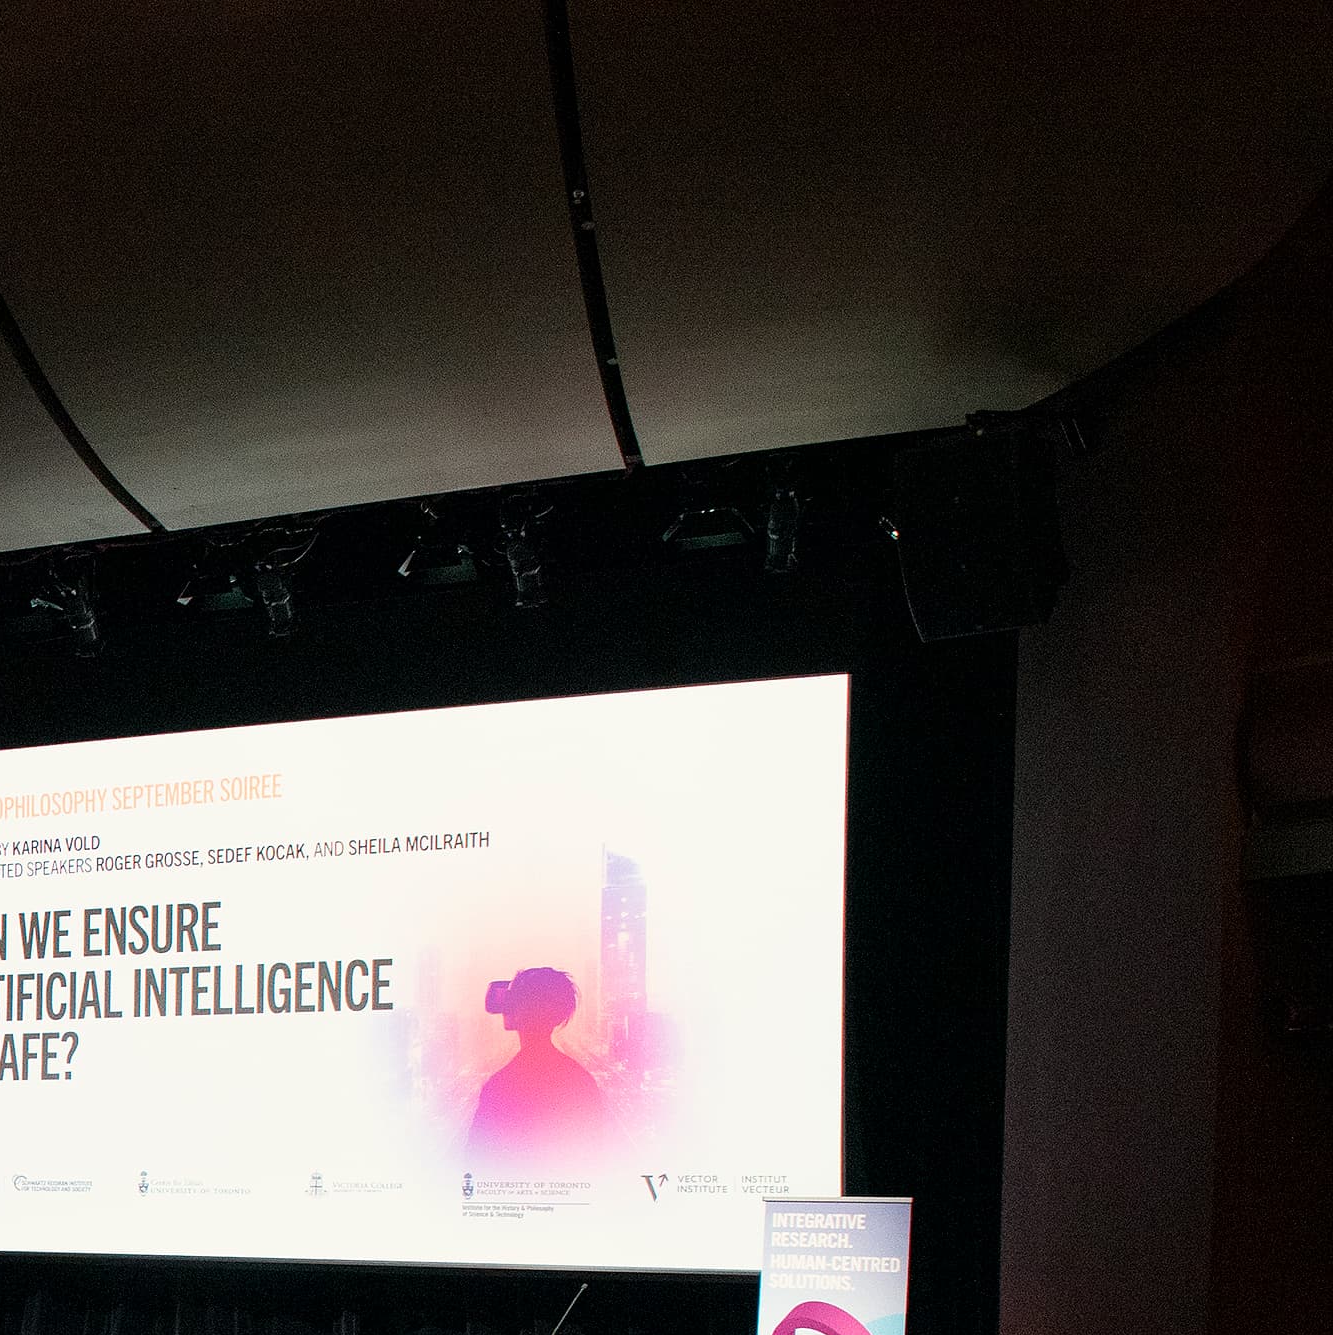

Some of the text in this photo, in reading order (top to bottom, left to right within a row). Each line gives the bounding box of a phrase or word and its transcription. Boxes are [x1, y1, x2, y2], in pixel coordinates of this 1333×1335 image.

[112, 779, 214, 810] SEPTEMBER
[220, 774, 282, 802] SOIREE
[12, 838, 61, 856] KARINA
[65, 835, 100, 852] VOLD
[27, 858, 92, 877] SPEAKERS
[96, 855, 141, 872] ROGER
[145, 850, 204, 868] GROSSE,
[208, 847, 252, 865] SEDEF
[256, 843, 309, 862] KOCAK,
[314, 840, 344, 857] AND
[348, 836, 401, 856] SHEILA
[406, 832, 489, 852] MCILRAITH
[19, 910, 72, 959] WE
[83, 901, 221, 957] ENSURE
[133, 958, 394, 1018] INTELLIGENCE
[773, 1213, 866, 1229] INTEGRATIVE
[771, 1232, 853, 1248] RESEARCH.
[770, 1254, 901, 1272] HUMAN-CENTRED
[769, 1273, 855, 1290] SOLUTIONS.
